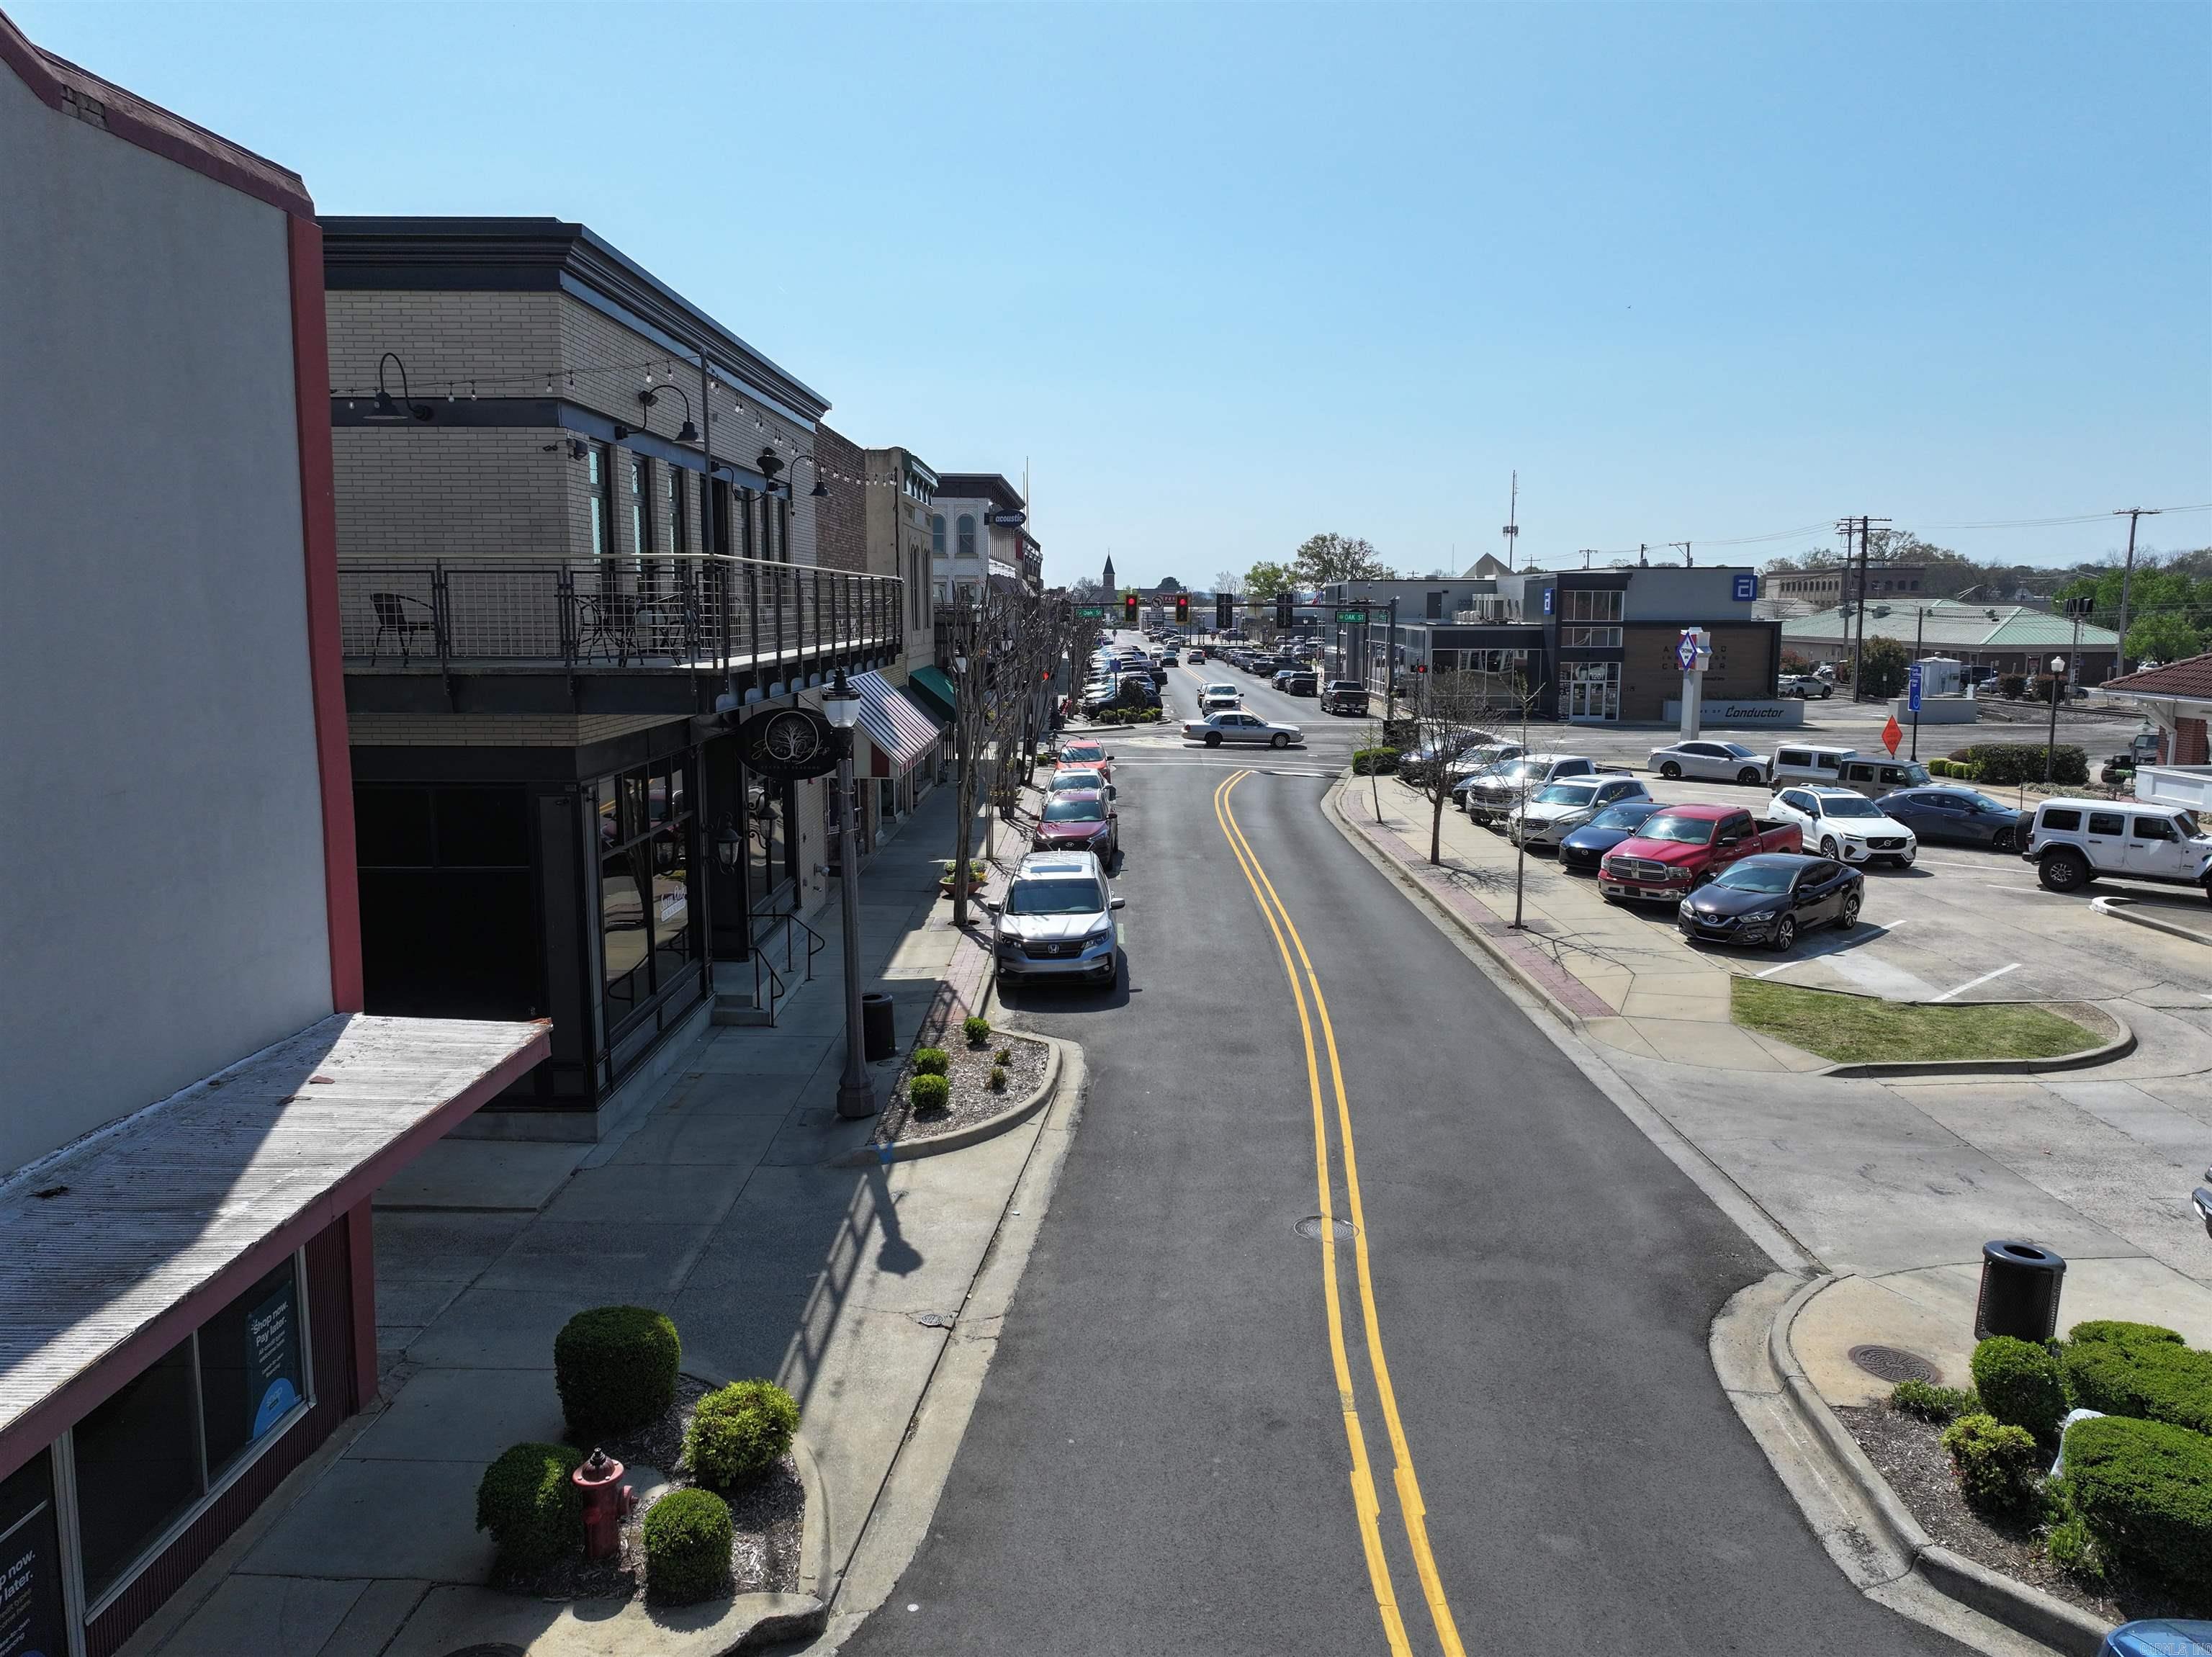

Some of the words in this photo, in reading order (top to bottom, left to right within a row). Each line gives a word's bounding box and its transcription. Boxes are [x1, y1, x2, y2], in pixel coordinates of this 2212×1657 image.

[995, 513, 1023, 523] acoustic
[1725, 705, 1784, 718] Conductor
[253, 1314, 272, 1335] Shop
[272, 1301, 289, 1321] now.
[256, 1330, 269, 1347] Pay
[270, 1316, 287, 1336] later.
[6, 1550, 35, 1579] now.
[4, 1570, 34, 1602] later.
